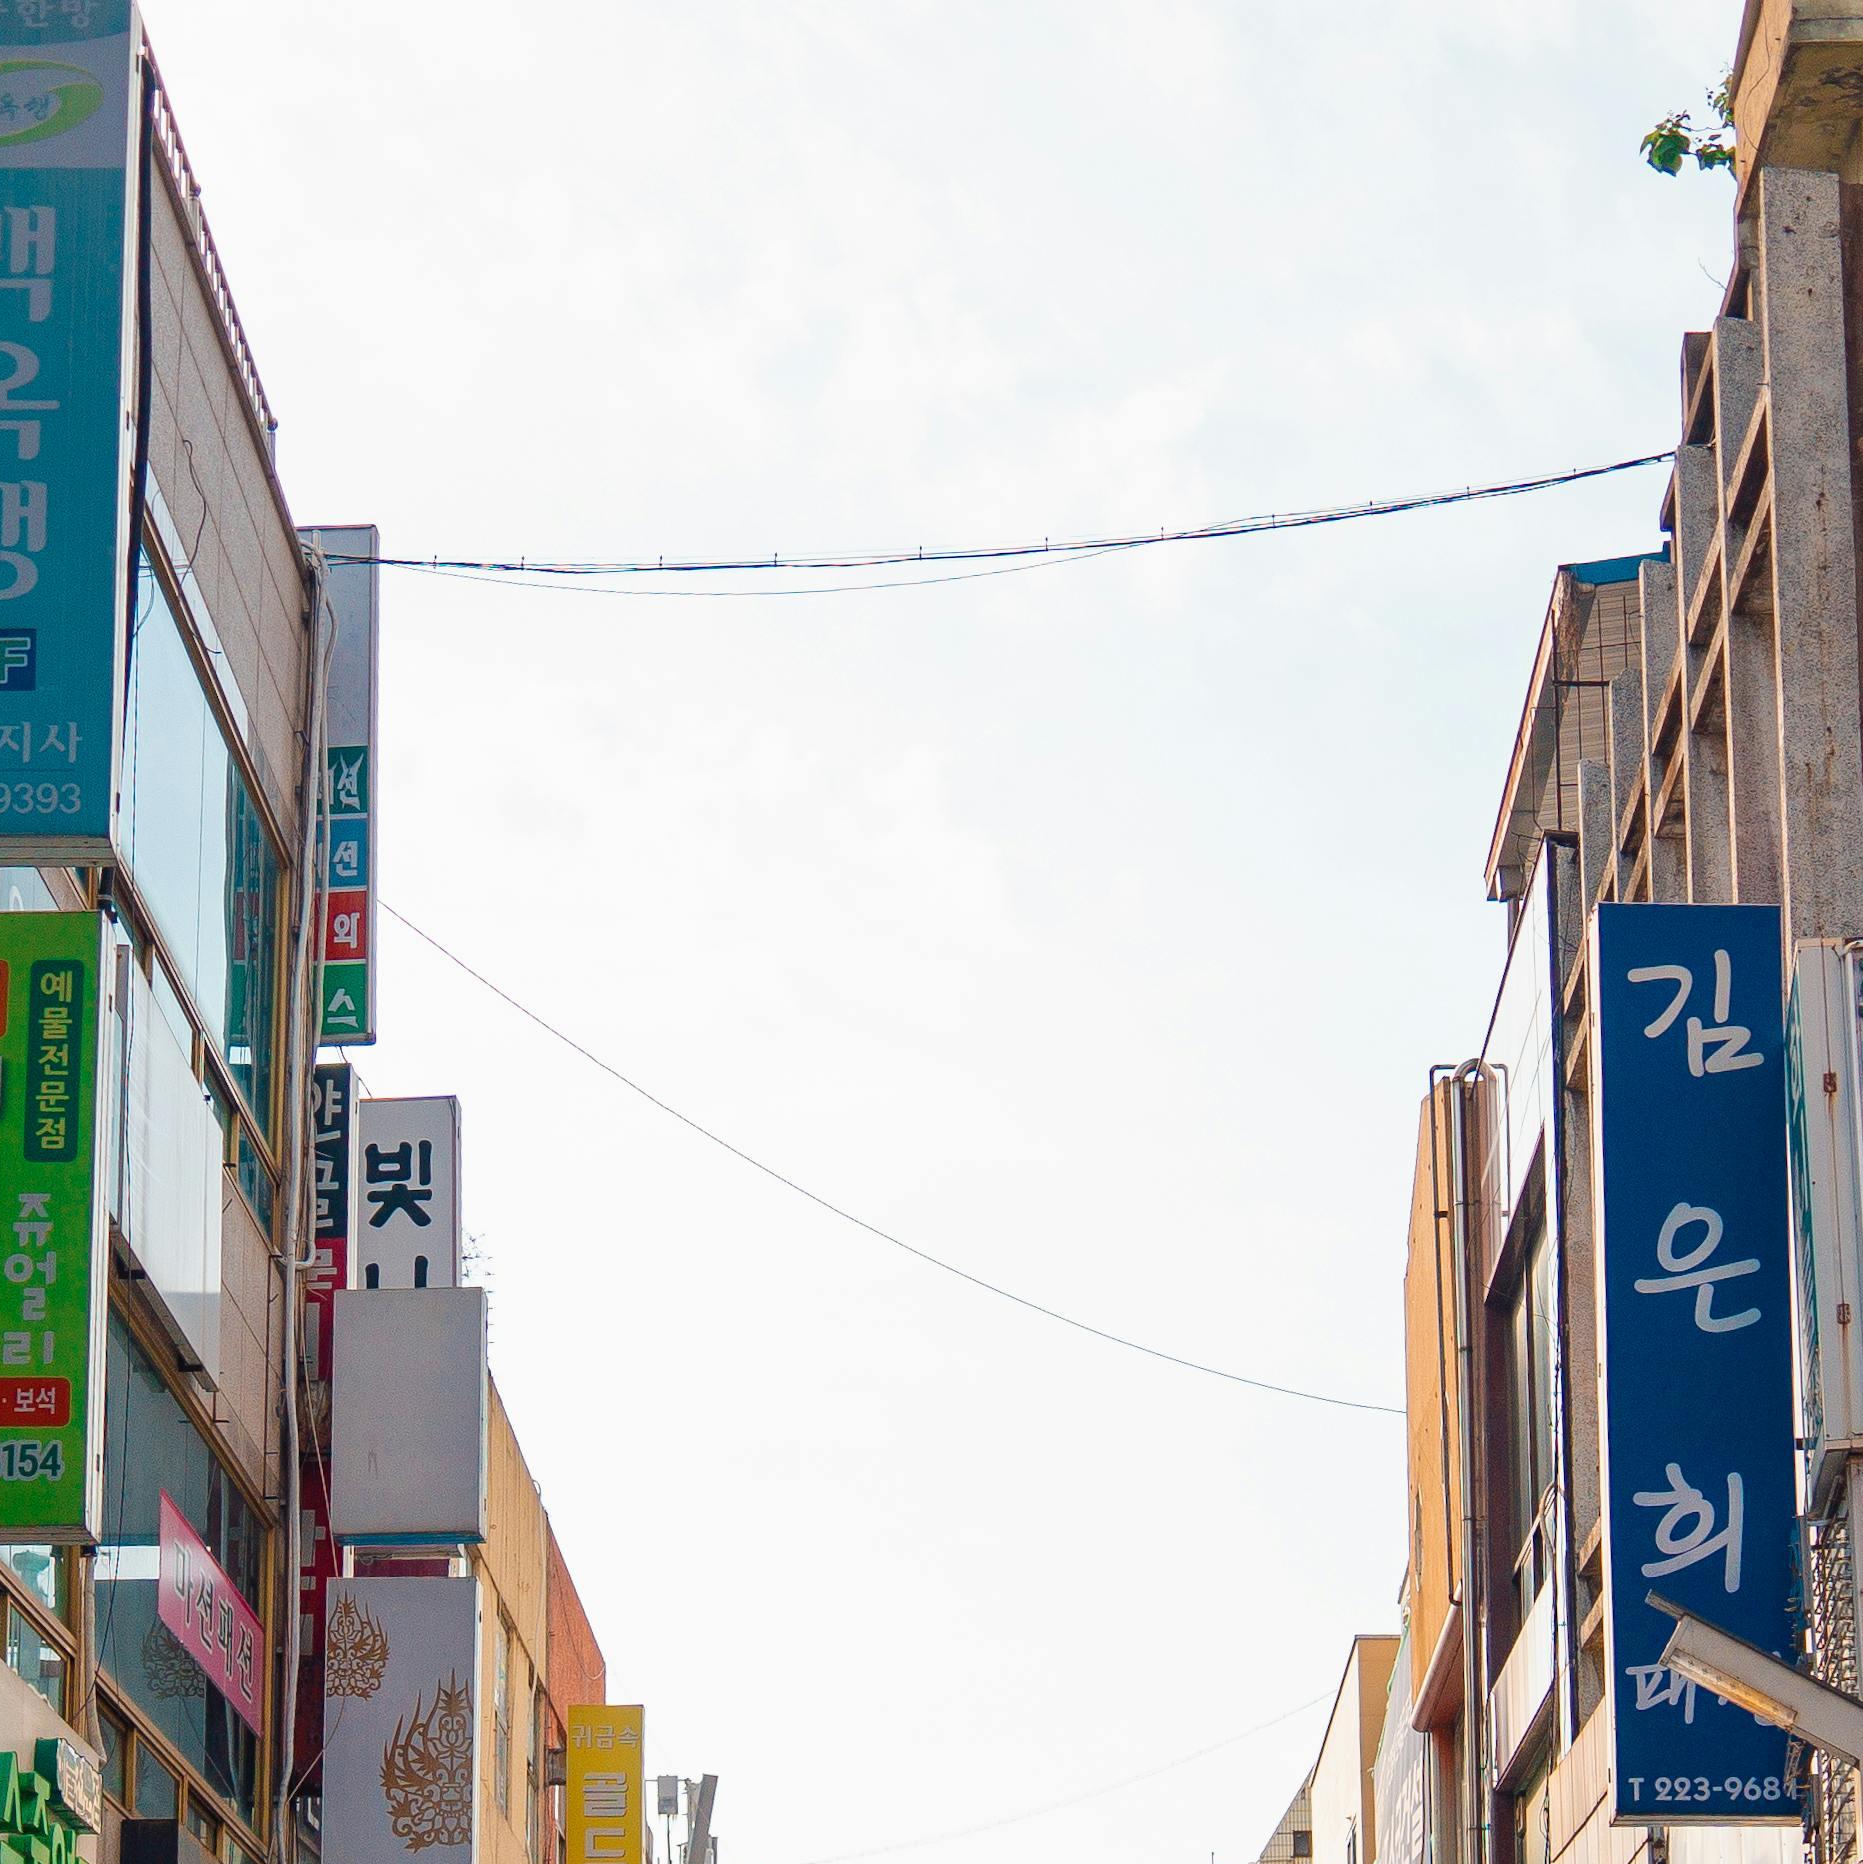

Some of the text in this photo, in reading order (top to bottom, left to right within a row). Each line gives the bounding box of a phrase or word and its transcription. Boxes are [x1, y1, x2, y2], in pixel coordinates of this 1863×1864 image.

[34, 970, 74, 1151] 예물전문점
[1, 1193, 58, 1367] 쥬얼리
[1626, 948, 1764, 1593] 김은희
[571, 1722, 638, 1751] 귀금속
[1627, 1777, 1645, 1802] T
